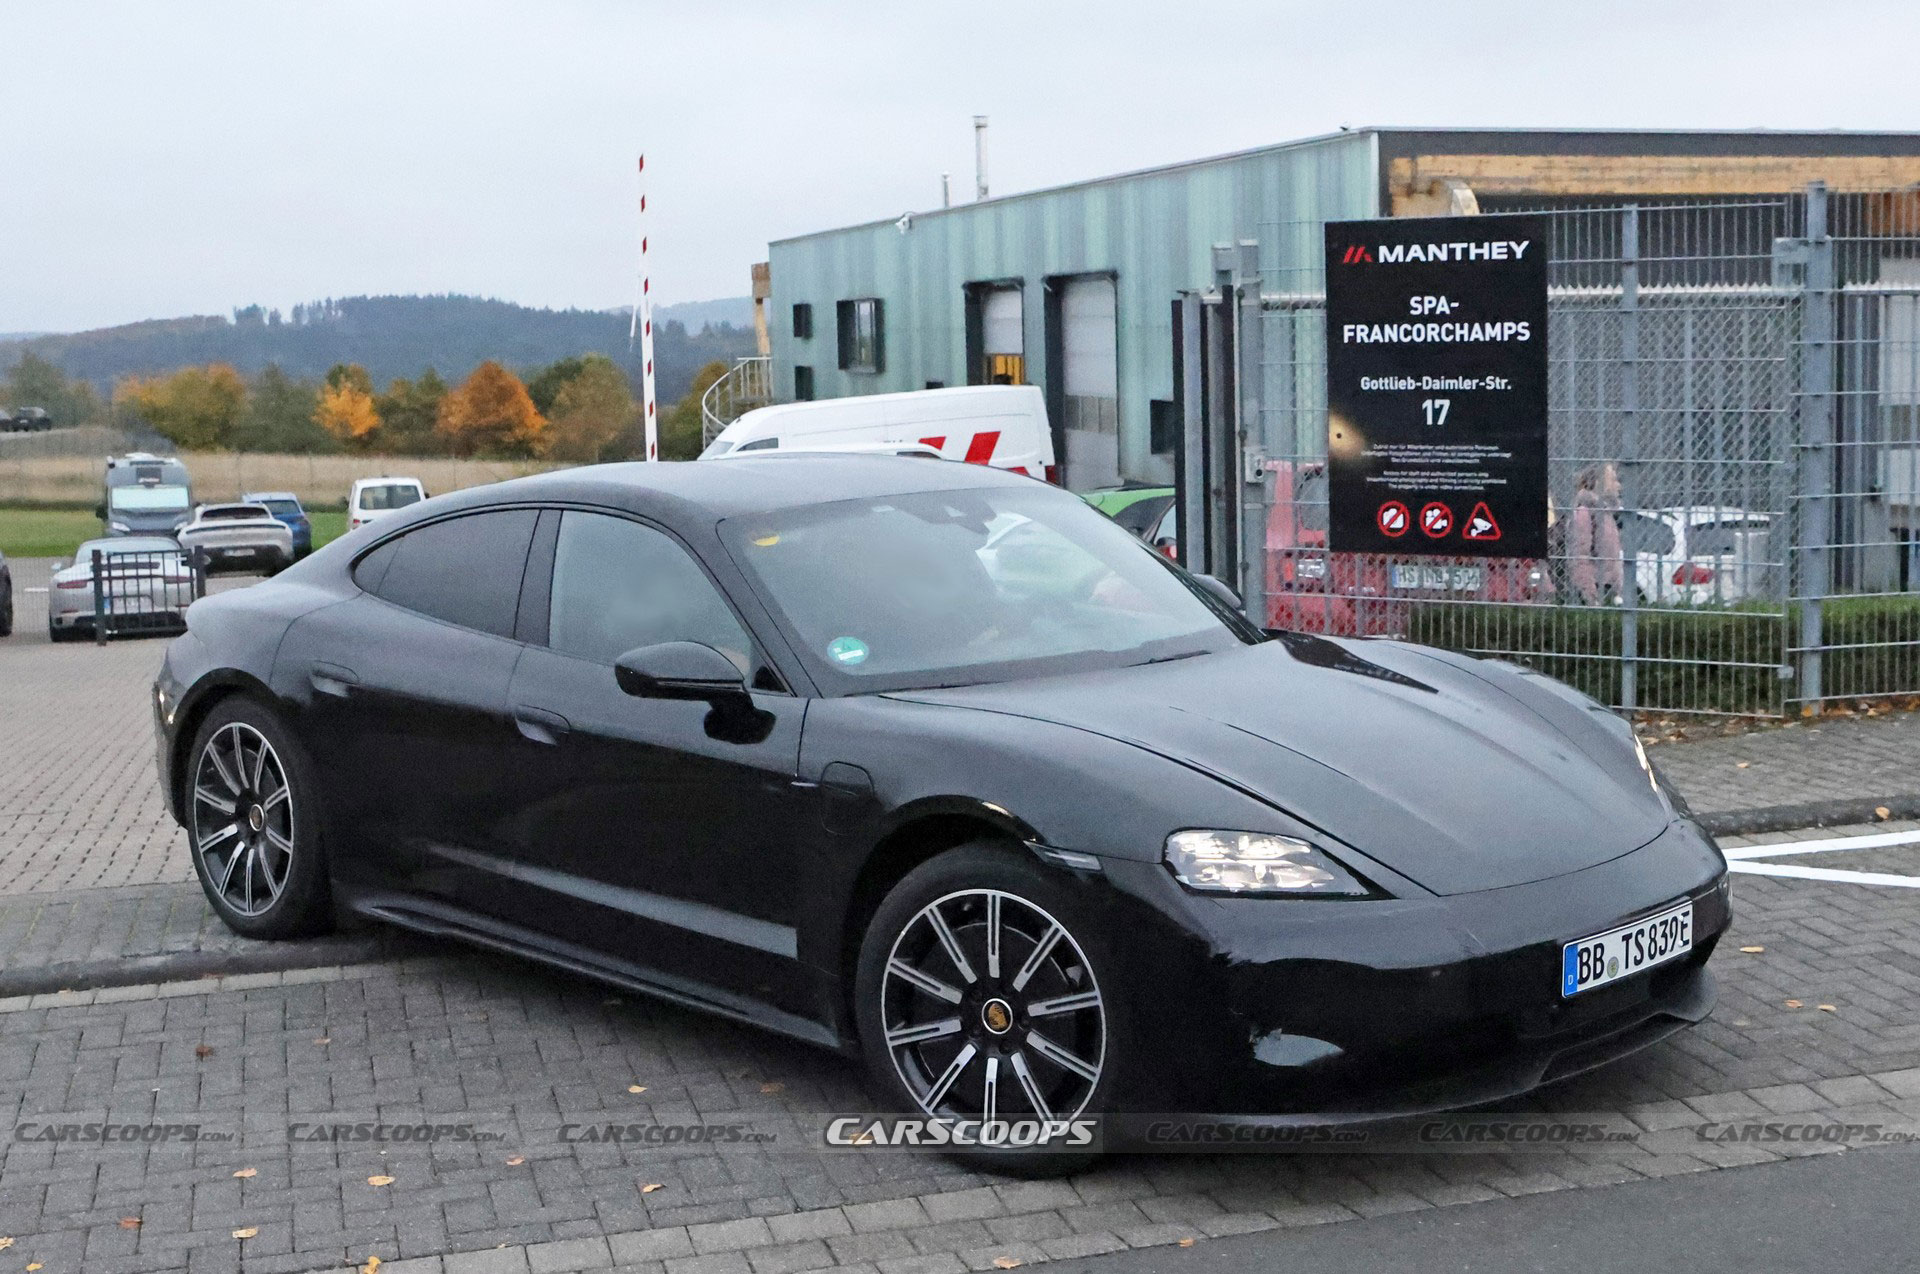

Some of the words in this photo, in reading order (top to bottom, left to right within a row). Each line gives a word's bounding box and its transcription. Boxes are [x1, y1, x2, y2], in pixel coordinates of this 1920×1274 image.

[1378, 241, 1530, 263] MANTHEY
[1409, 296, 1459, 316] SPA-
[1343, 322, 1531, 343] FRANCORCHAMPS
[1360, 376, 1512, 391] Gottlieb-Daimler-Str.
[1421, 399, 1451, 425] 17
[1577, 942, 1605, 985] BB
